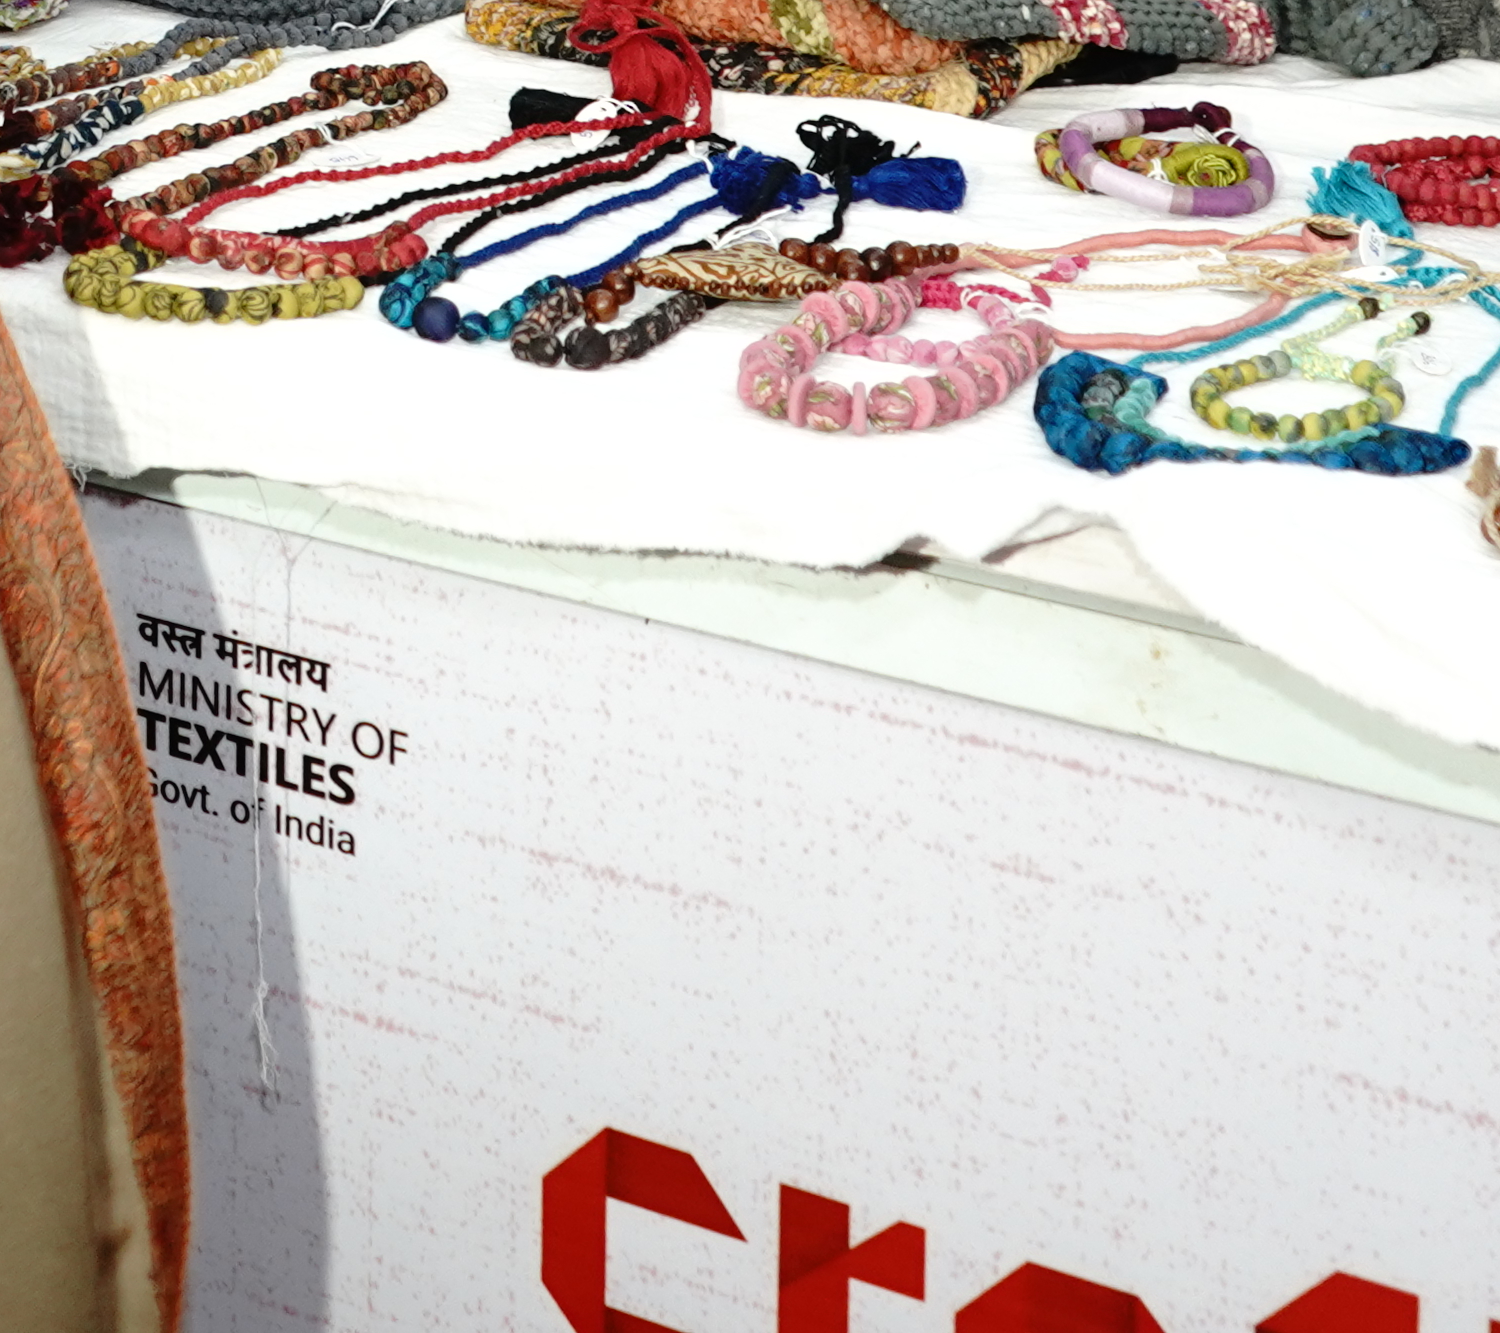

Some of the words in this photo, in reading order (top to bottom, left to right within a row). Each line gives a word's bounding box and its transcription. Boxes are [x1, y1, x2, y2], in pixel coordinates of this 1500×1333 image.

[136, 708, 356, 806] TEXTILES
[138, 661, 336, 747] MINISTRY
[351, 721, 409, 766] OF
[230, 797, 265, 825] of
[275, 804, 356, 857] India
